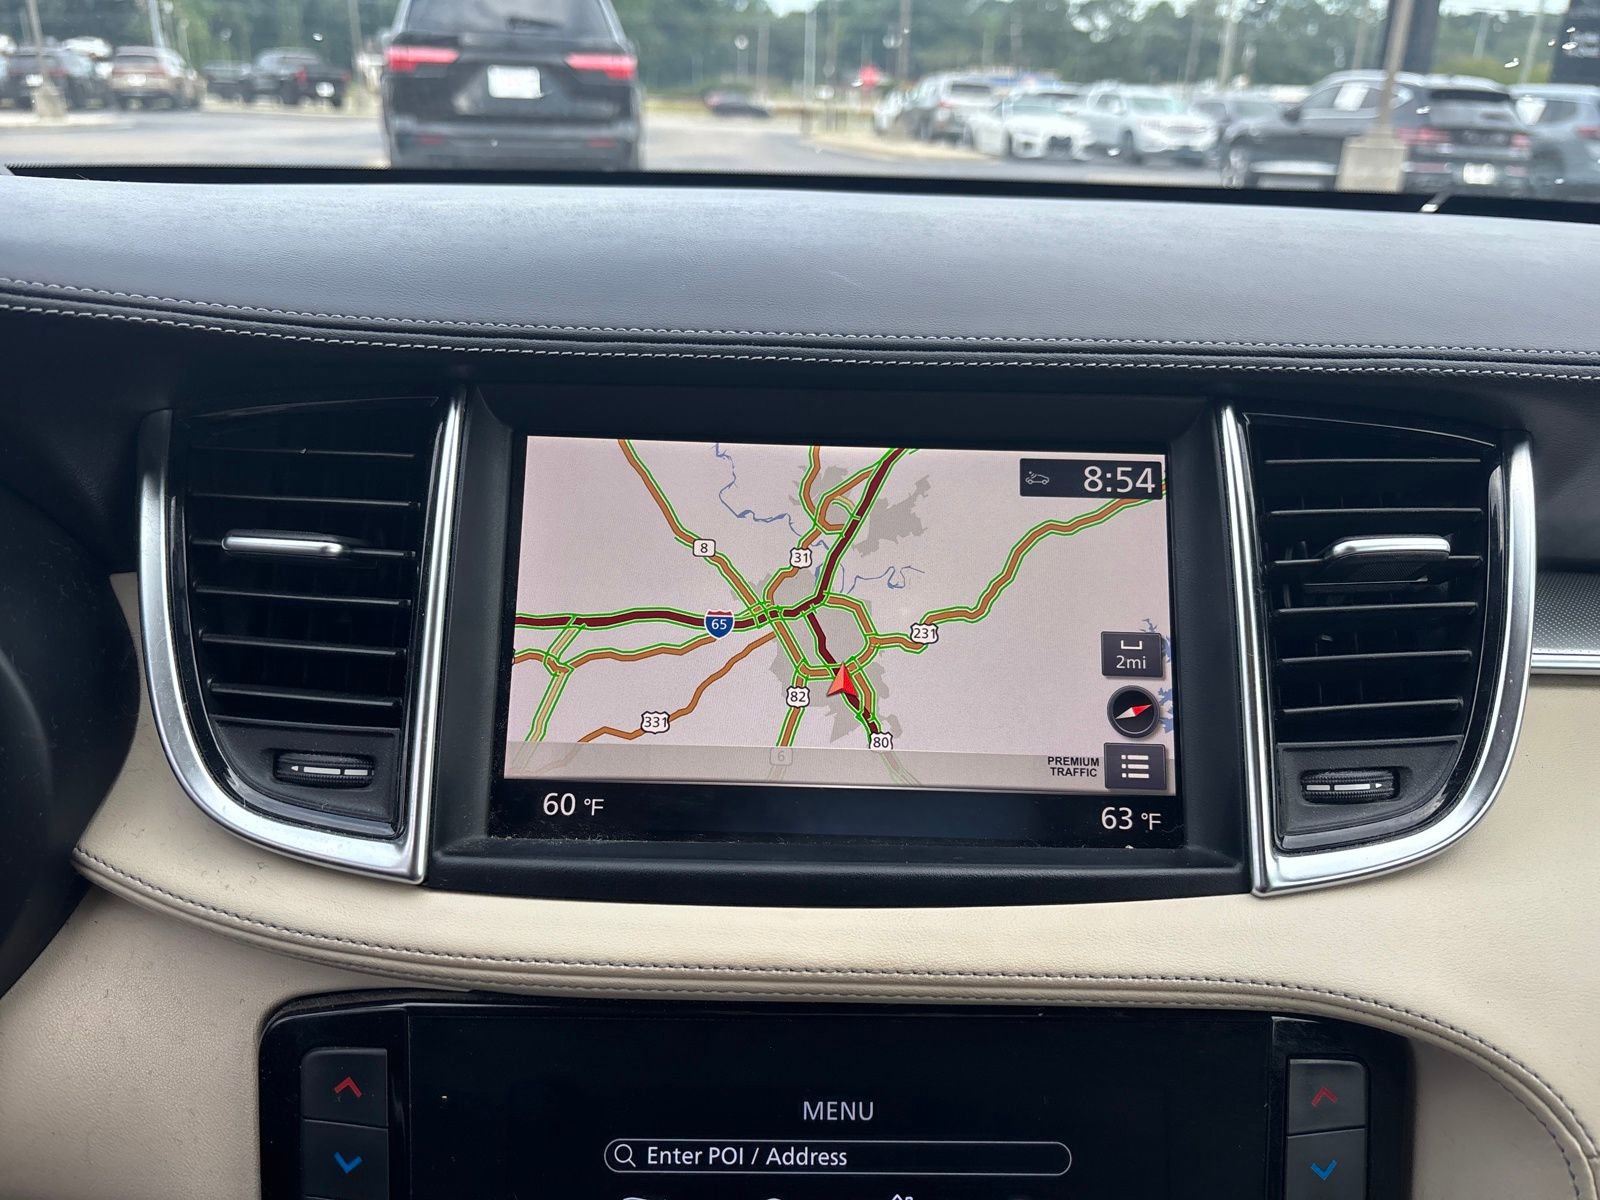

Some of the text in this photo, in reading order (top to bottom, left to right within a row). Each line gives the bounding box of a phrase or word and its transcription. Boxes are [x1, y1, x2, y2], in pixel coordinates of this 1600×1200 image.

[1083, 465, 1156, 494] 8:54
[701, 543, 708, 554] 8
[794, 552, 808, 563] 31
[711, 617, 727, 631] 65
[914, 628, 937, 639] 231
[1116, 655, 1146, 670] 2mi
[790, 691, 806, 703] 82
[644, 717, 667, 728] 331
[873, 736, 889, 749] 80
[777, 751, 785, 762] 6
[1047, 756, 1100, 767] PREMIUM
[1050, 766, 1098, 777] TRAFFIC
[543, 793, 575, 815] 60
[1101, 807, 1133, 830] 63
[803, 1101, 874, 1121] MENU
[647, 1146, 848, 1167] Enter POI / Address
